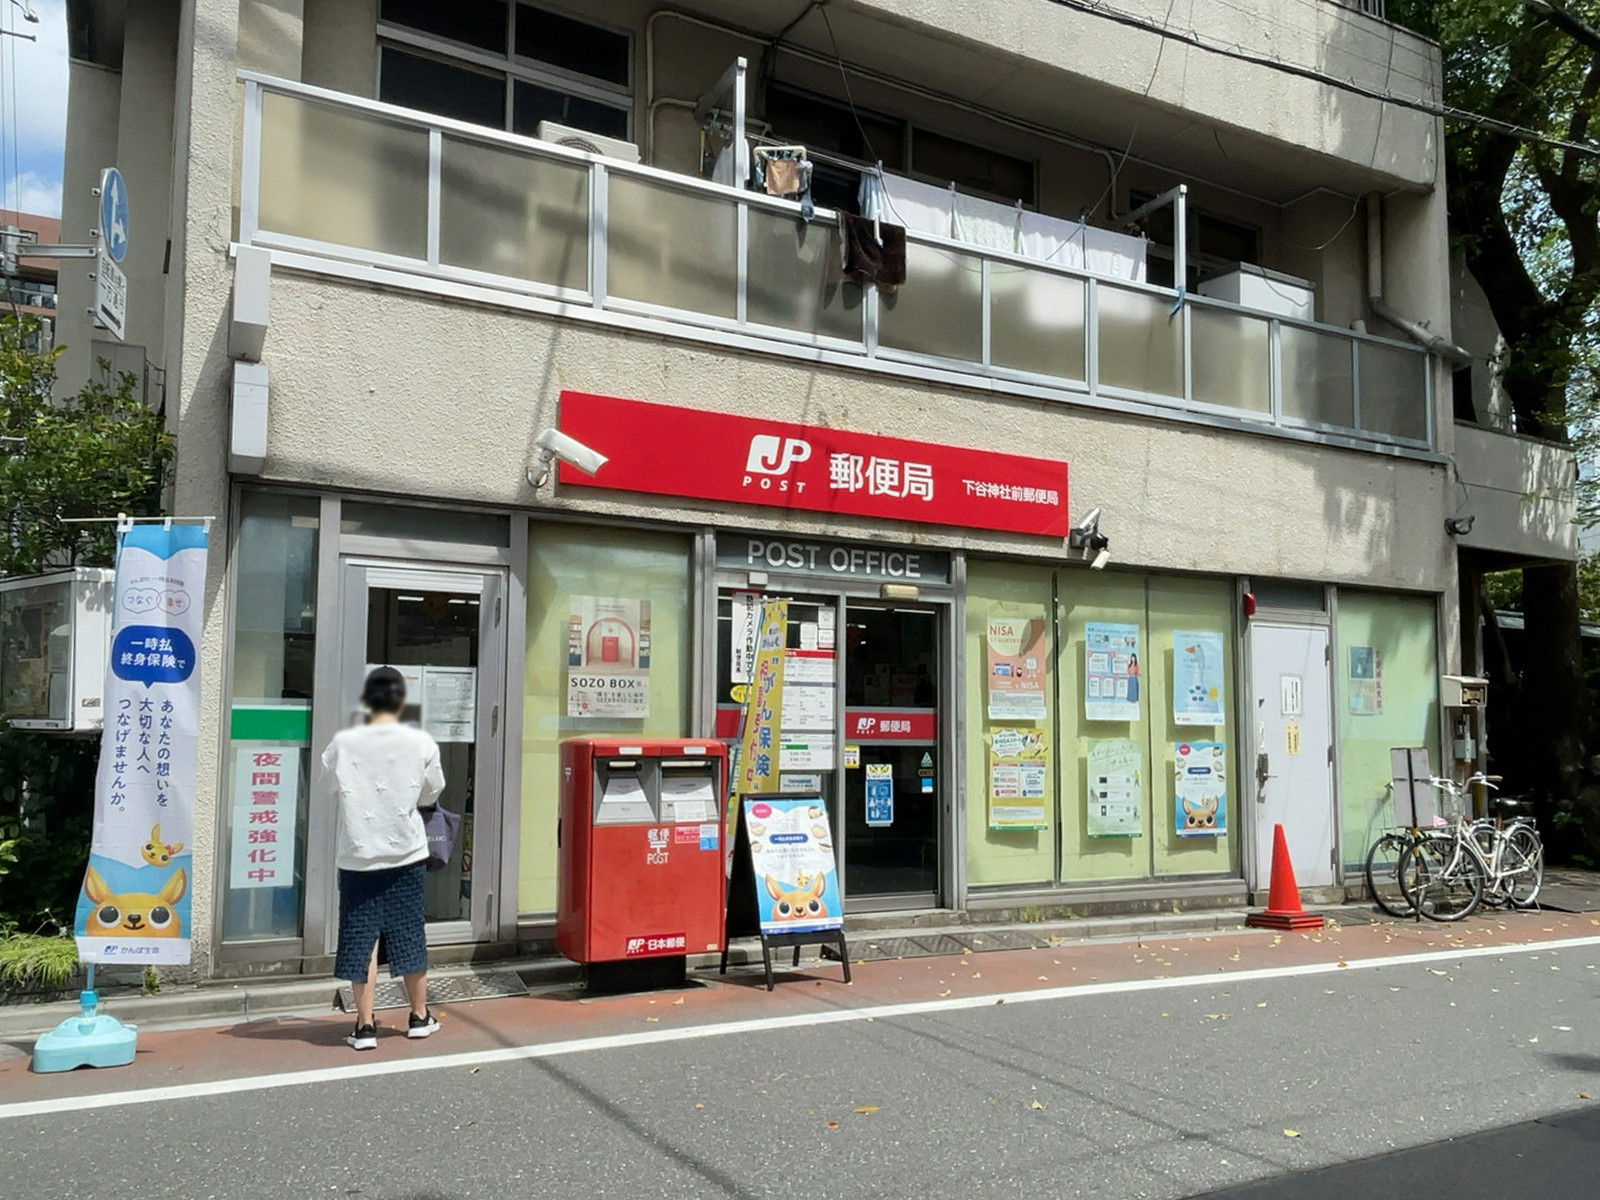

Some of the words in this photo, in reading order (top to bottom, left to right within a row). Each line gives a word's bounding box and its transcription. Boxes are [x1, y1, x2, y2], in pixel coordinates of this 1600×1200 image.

[742, 475, 806, 494] POST
[829, 453, 934, 501] 郵便局
[962, 479, 1059, 506] 下谷神社前郵便局
[747, 540, 821, 570] POST
[829, 547, 921, 578] OFFICE
[127, 594, 154, 606] つなぐ
[989, 626, 1014, 636] NISA
[131, 636, 173, 653] 一時払
[120, 651, 187, 669] 終身保険で
[571, 677, 605, 688] SOZO
[610, 679, 635, 689] BOX
[136, 697, 154, 774] 大切な人へ
[880, 720, 912, 733] 郵便局
[110, 698, 132, 812] つなげませんか。
[155, 699, 174, 807] あなたの想いを
[247, 752, 282, 882] 夜間警戒強化中
[648, 829, 670, 842] 郵便
[647, 852, 670, 864] POST
[647, 936, 685, 951] 日本郵便
